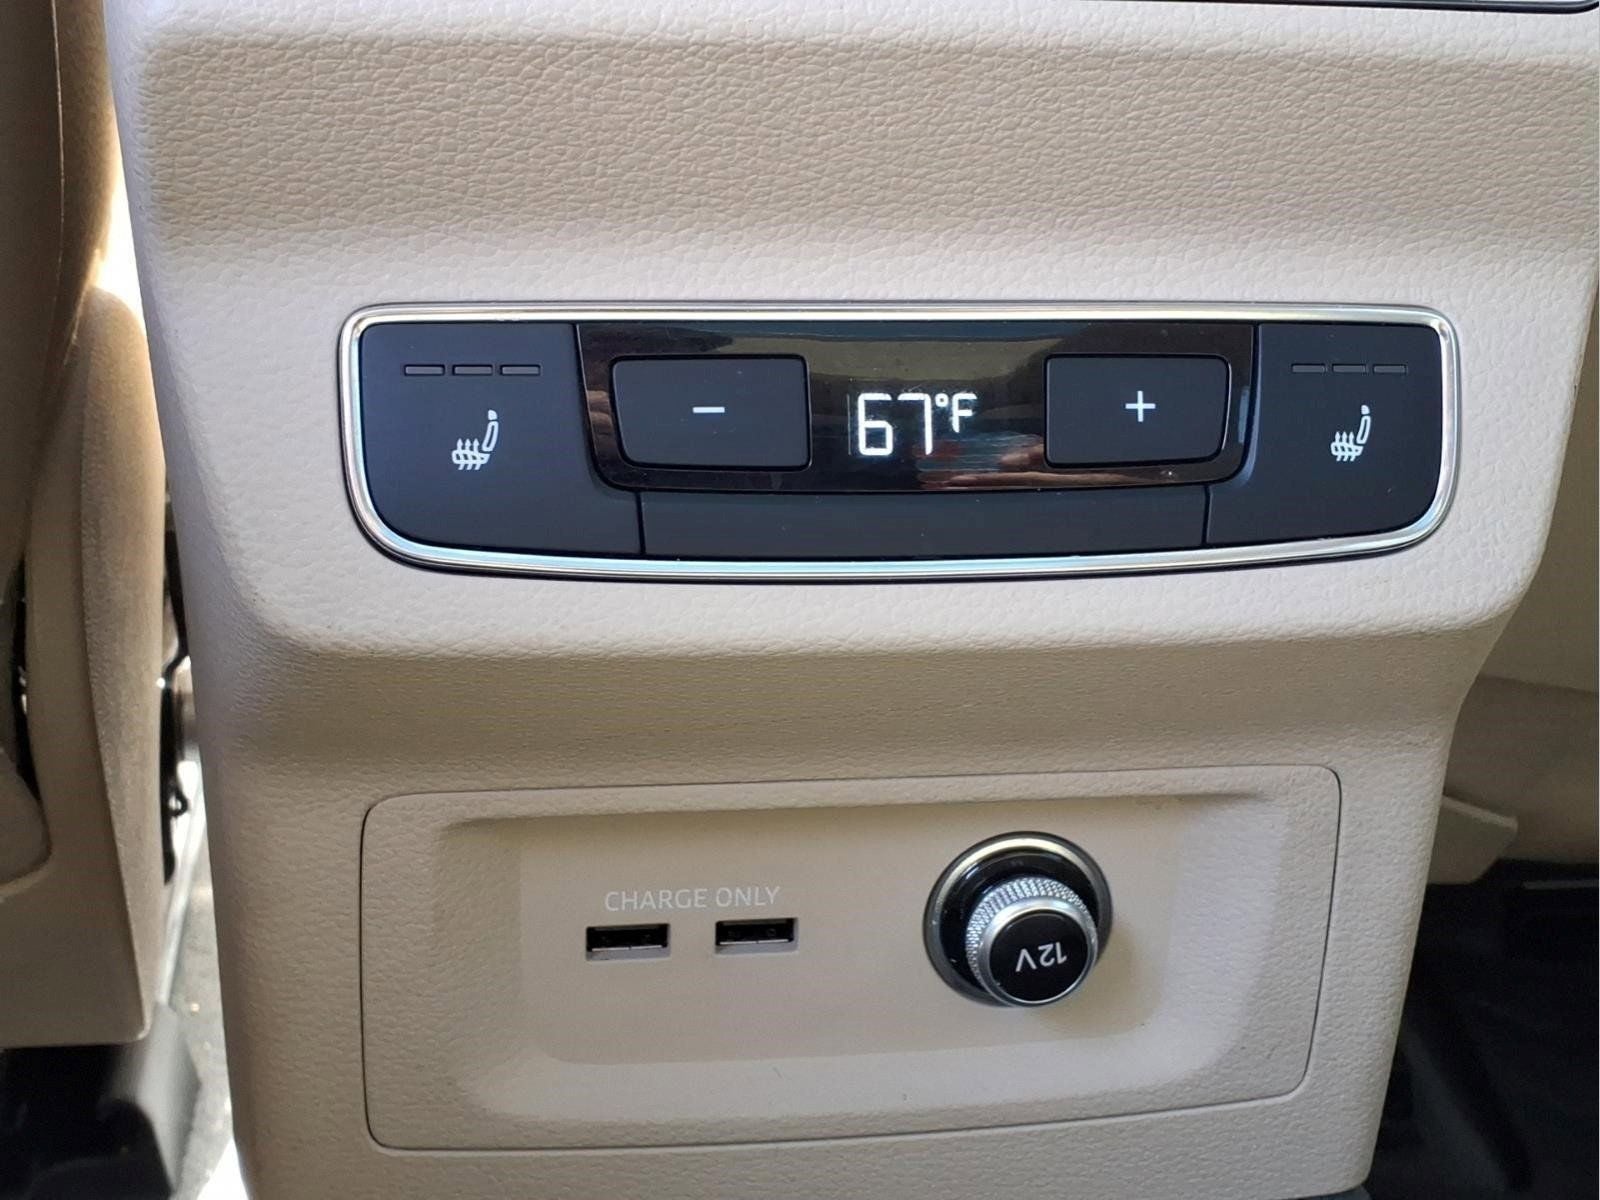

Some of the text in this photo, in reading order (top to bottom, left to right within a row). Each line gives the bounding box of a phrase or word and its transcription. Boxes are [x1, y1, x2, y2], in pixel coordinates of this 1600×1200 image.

[604, 885, 781, 912] CHARGE ONLY
[1015, 941, 1067, 972] 12V
